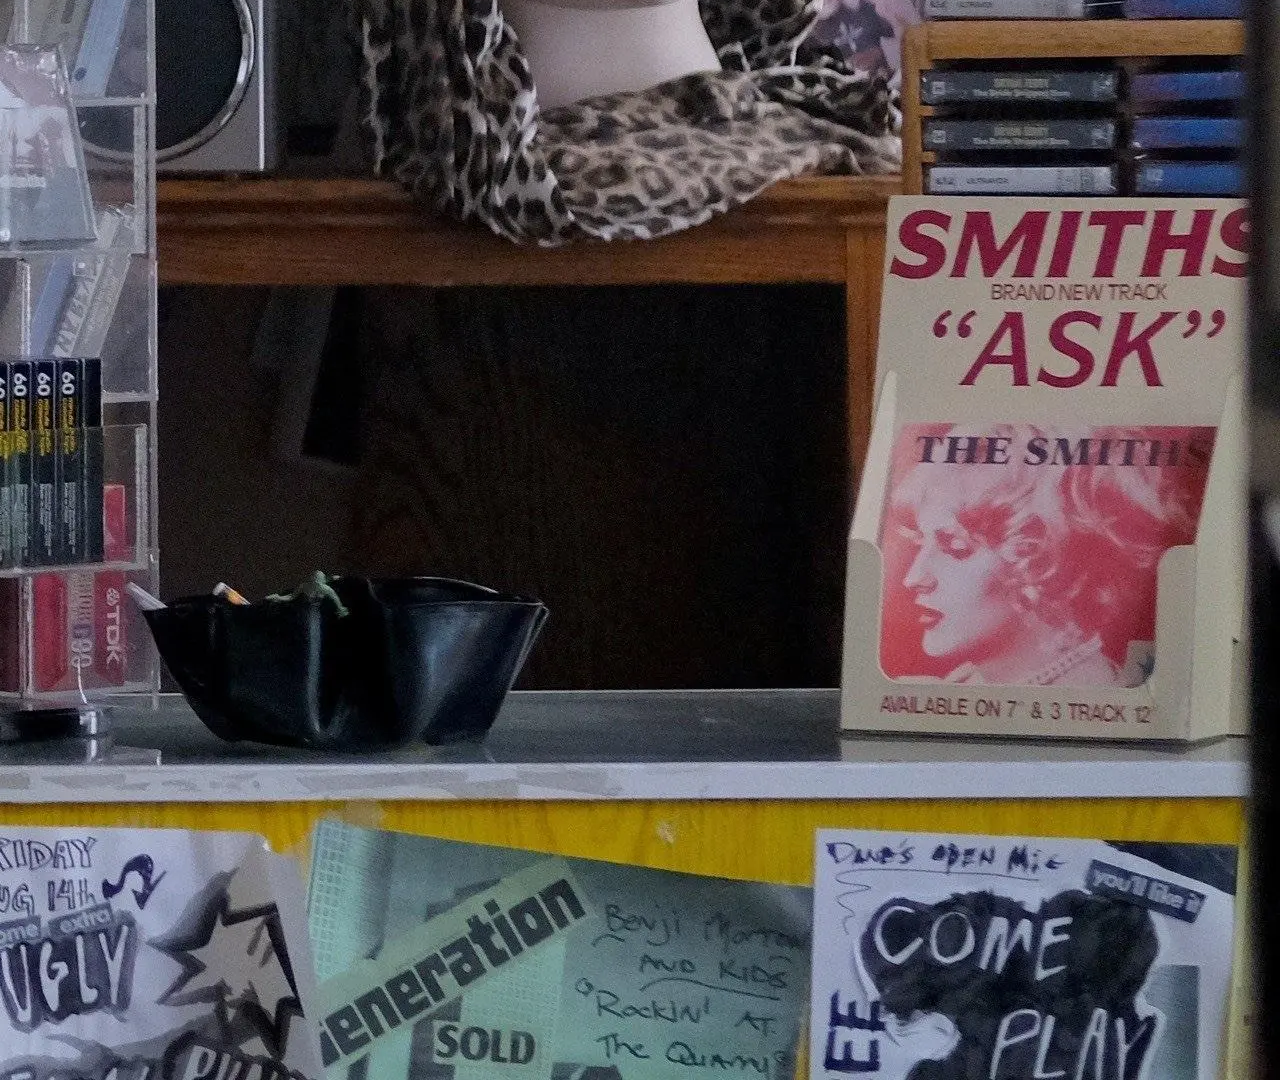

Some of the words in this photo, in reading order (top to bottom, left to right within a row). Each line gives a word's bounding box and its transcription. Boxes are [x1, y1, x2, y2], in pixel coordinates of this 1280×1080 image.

[890, 208, 1248, 280] SMITHS
[990, 283, 1056, 300] BRAND
[1059, 283, 1105, 300] NEW
[1108, 283, 1167, 300] TRACK
[14, 373, 27, 397] 60
[37, 372, 51, 398] 60
[62, 371, 75, 395] 60
[916, 437, 1013, 466] THE
[1023, 437, 1218, 468] SMITHS
[106, 604, 126, 668] TDK
[880, 696, 967, 716] AVAILABLE
[974, 699, 1001, 717] ON
[1051, 702, 1062, 719] 3
[1068, 703, 1128, 723] TRACK
[47, 877, 98, 912] 14th
[60, 908, 112, 934] extra
[874, 906, 1074, 980] COME
[0, 924, 129, 1022] UGLY
[320, 879, 586, 1067] eneration
[436, 1024, 536, 1065] SOLD
[991, 1008, 1148, 1080] PLAY
